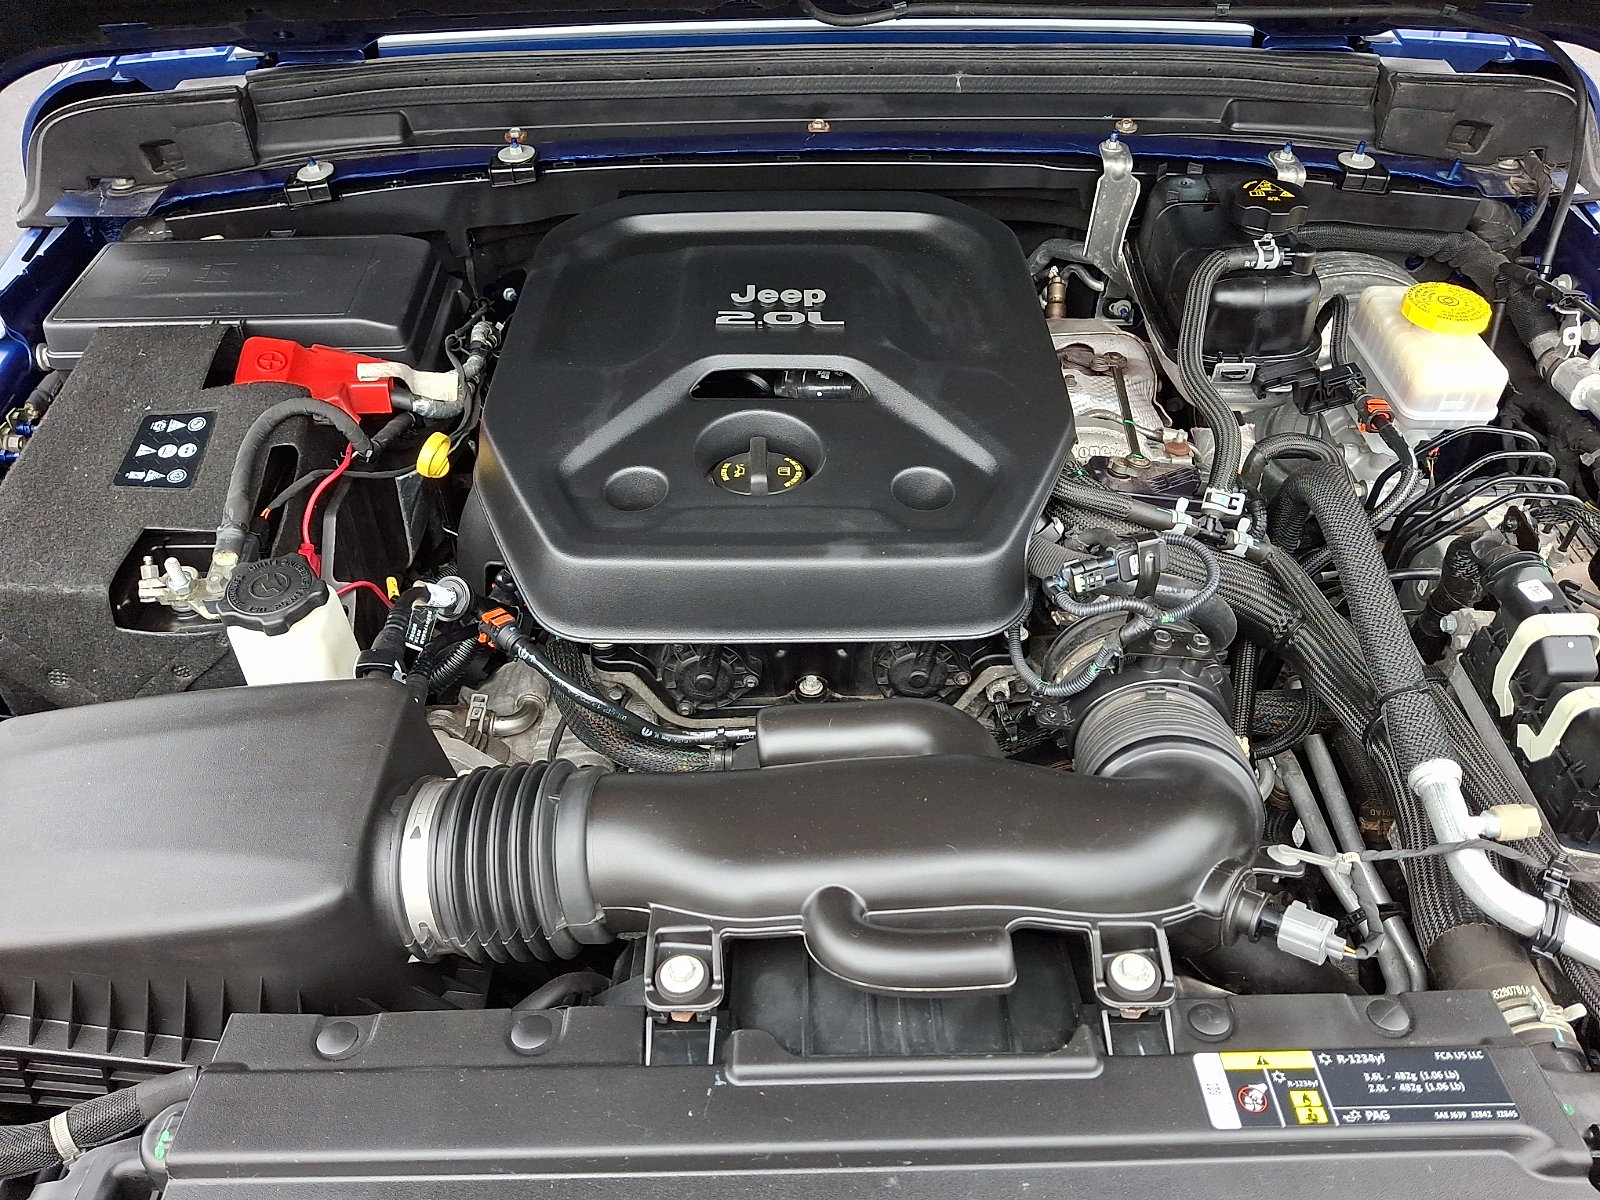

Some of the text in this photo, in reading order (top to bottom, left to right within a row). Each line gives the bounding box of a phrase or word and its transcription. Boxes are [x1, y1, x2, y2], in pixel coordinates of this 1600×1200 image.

[730, 284, 827, 307] Jeep
[715, 310, 845, 326] 2.0L
[1336, 1052, 1386, 1066] R-1234yf
[1434, 1050, 1484, 1060] FCA US LLC
[1363, 1072, 1384, 1082] 3.6L
[1394, 1072, 1418, 1082] 482g
[1419, 1070, 1444, 1081] (1.06
[1444, 1069, 1460, 1081] Lb)
[1368, 1083, 1389, 1093] 2.0L
[1399, 1083, 1424, 1094] 482g
[1425, 1081, 1450, 1093] (1.06
[1449, 1081, 1466, 1093] Lb)
[1365, 1109, 1391, 1121] PAG
